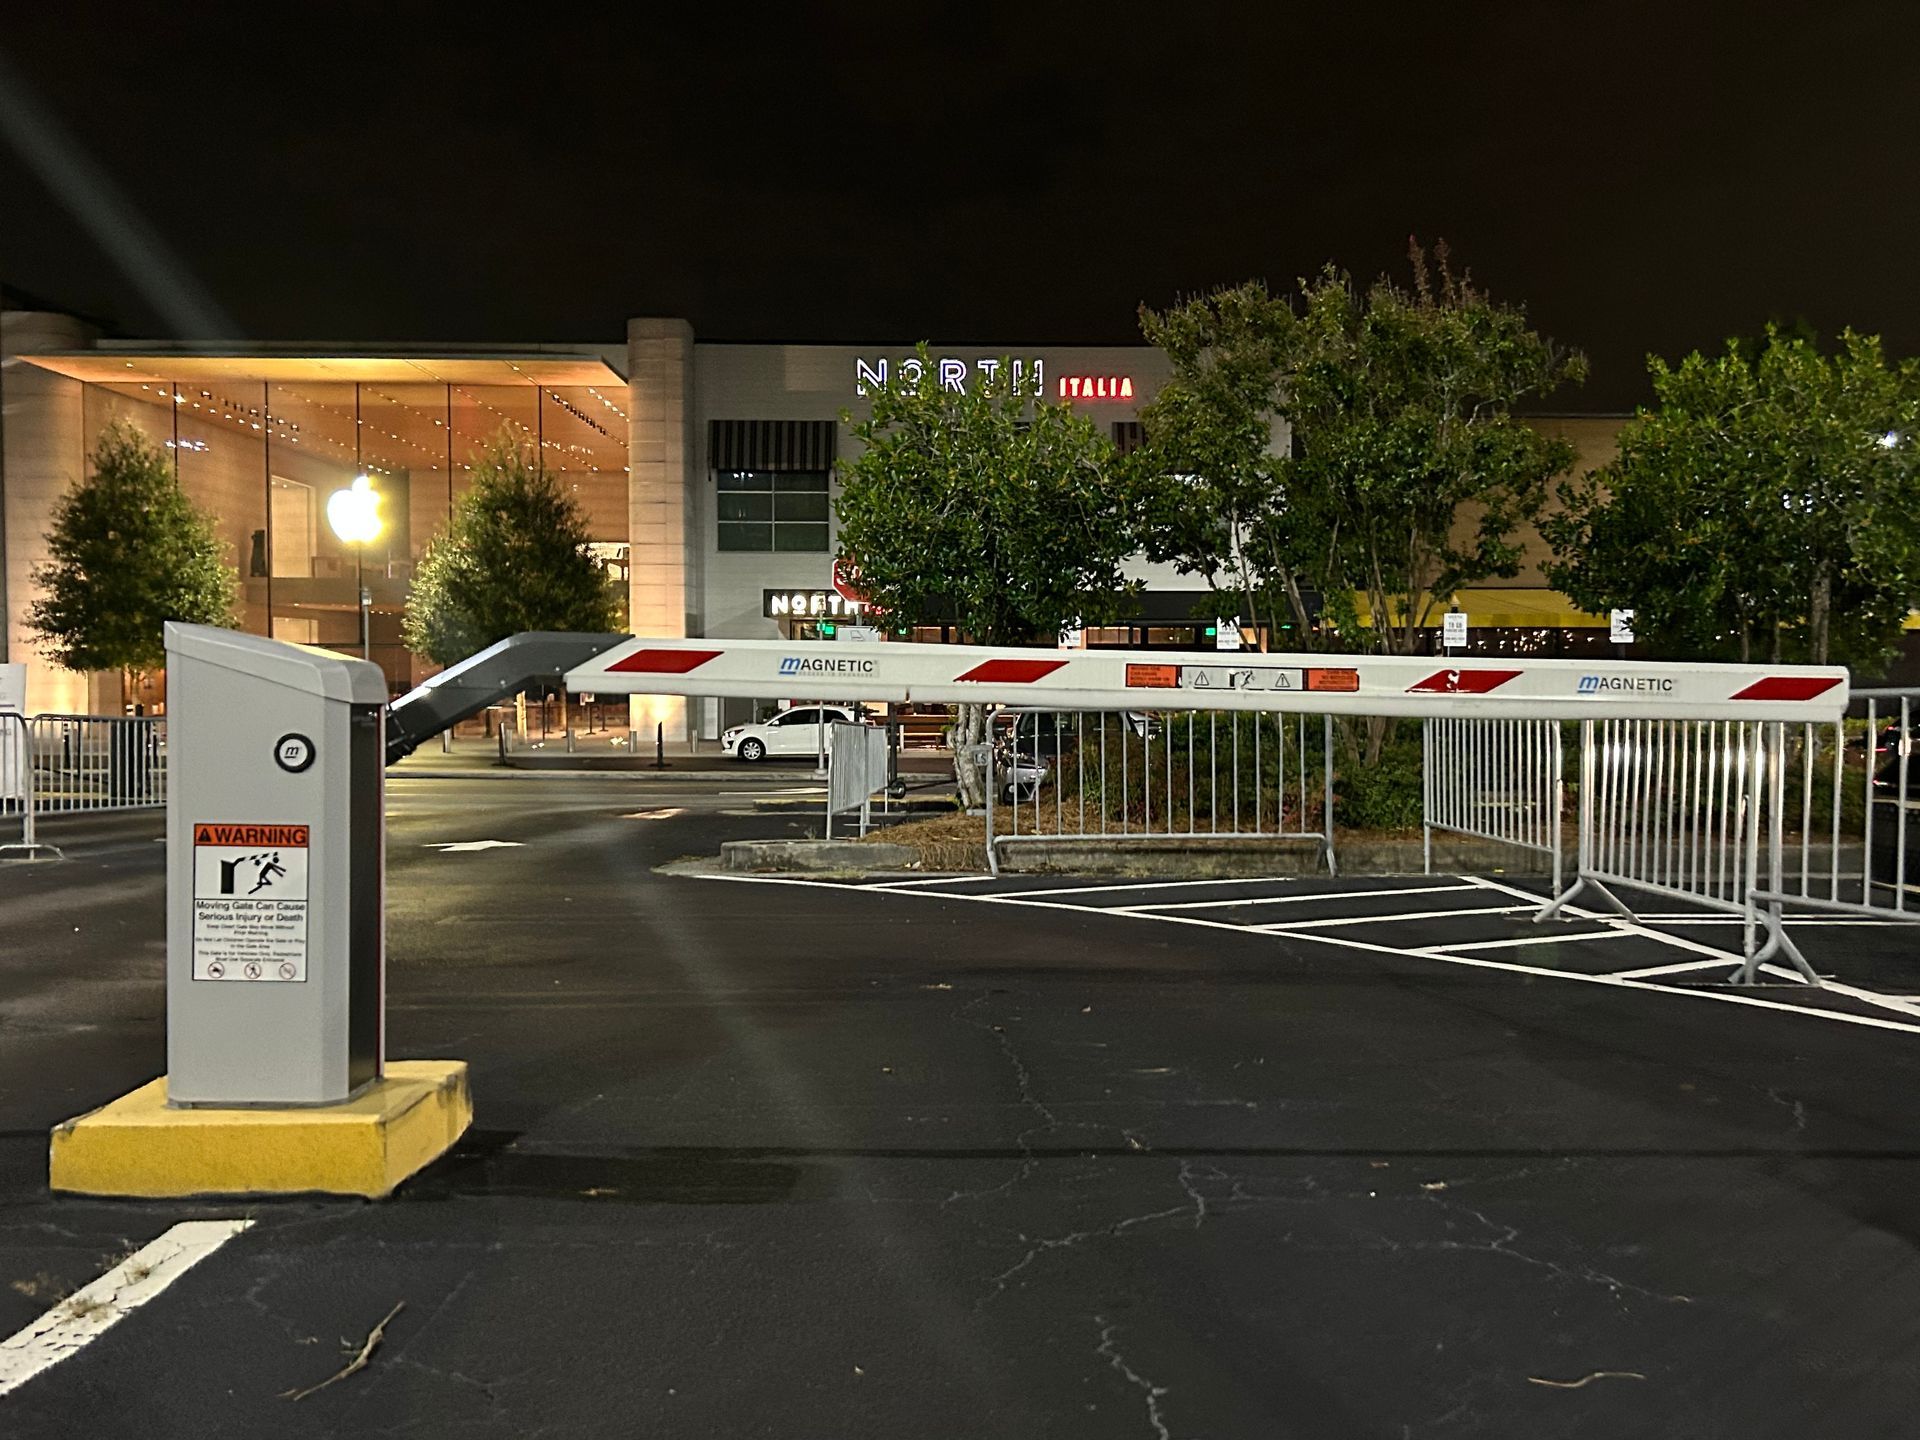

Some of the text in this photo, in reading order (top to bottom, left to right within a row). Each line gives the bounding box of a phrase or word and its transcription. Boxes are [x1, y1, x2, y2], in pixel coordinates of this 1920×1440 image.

[857, 358, 1133, 397] NORTH ITALIA
[213, 828, 307, 844] WARNING
[196, 901, 305, 911] Moving Gate Can Cause
[198, 912, 234, 921] Serious
[236, 912, 262, 923] Injury
[276, 913, 303, 922] Death
